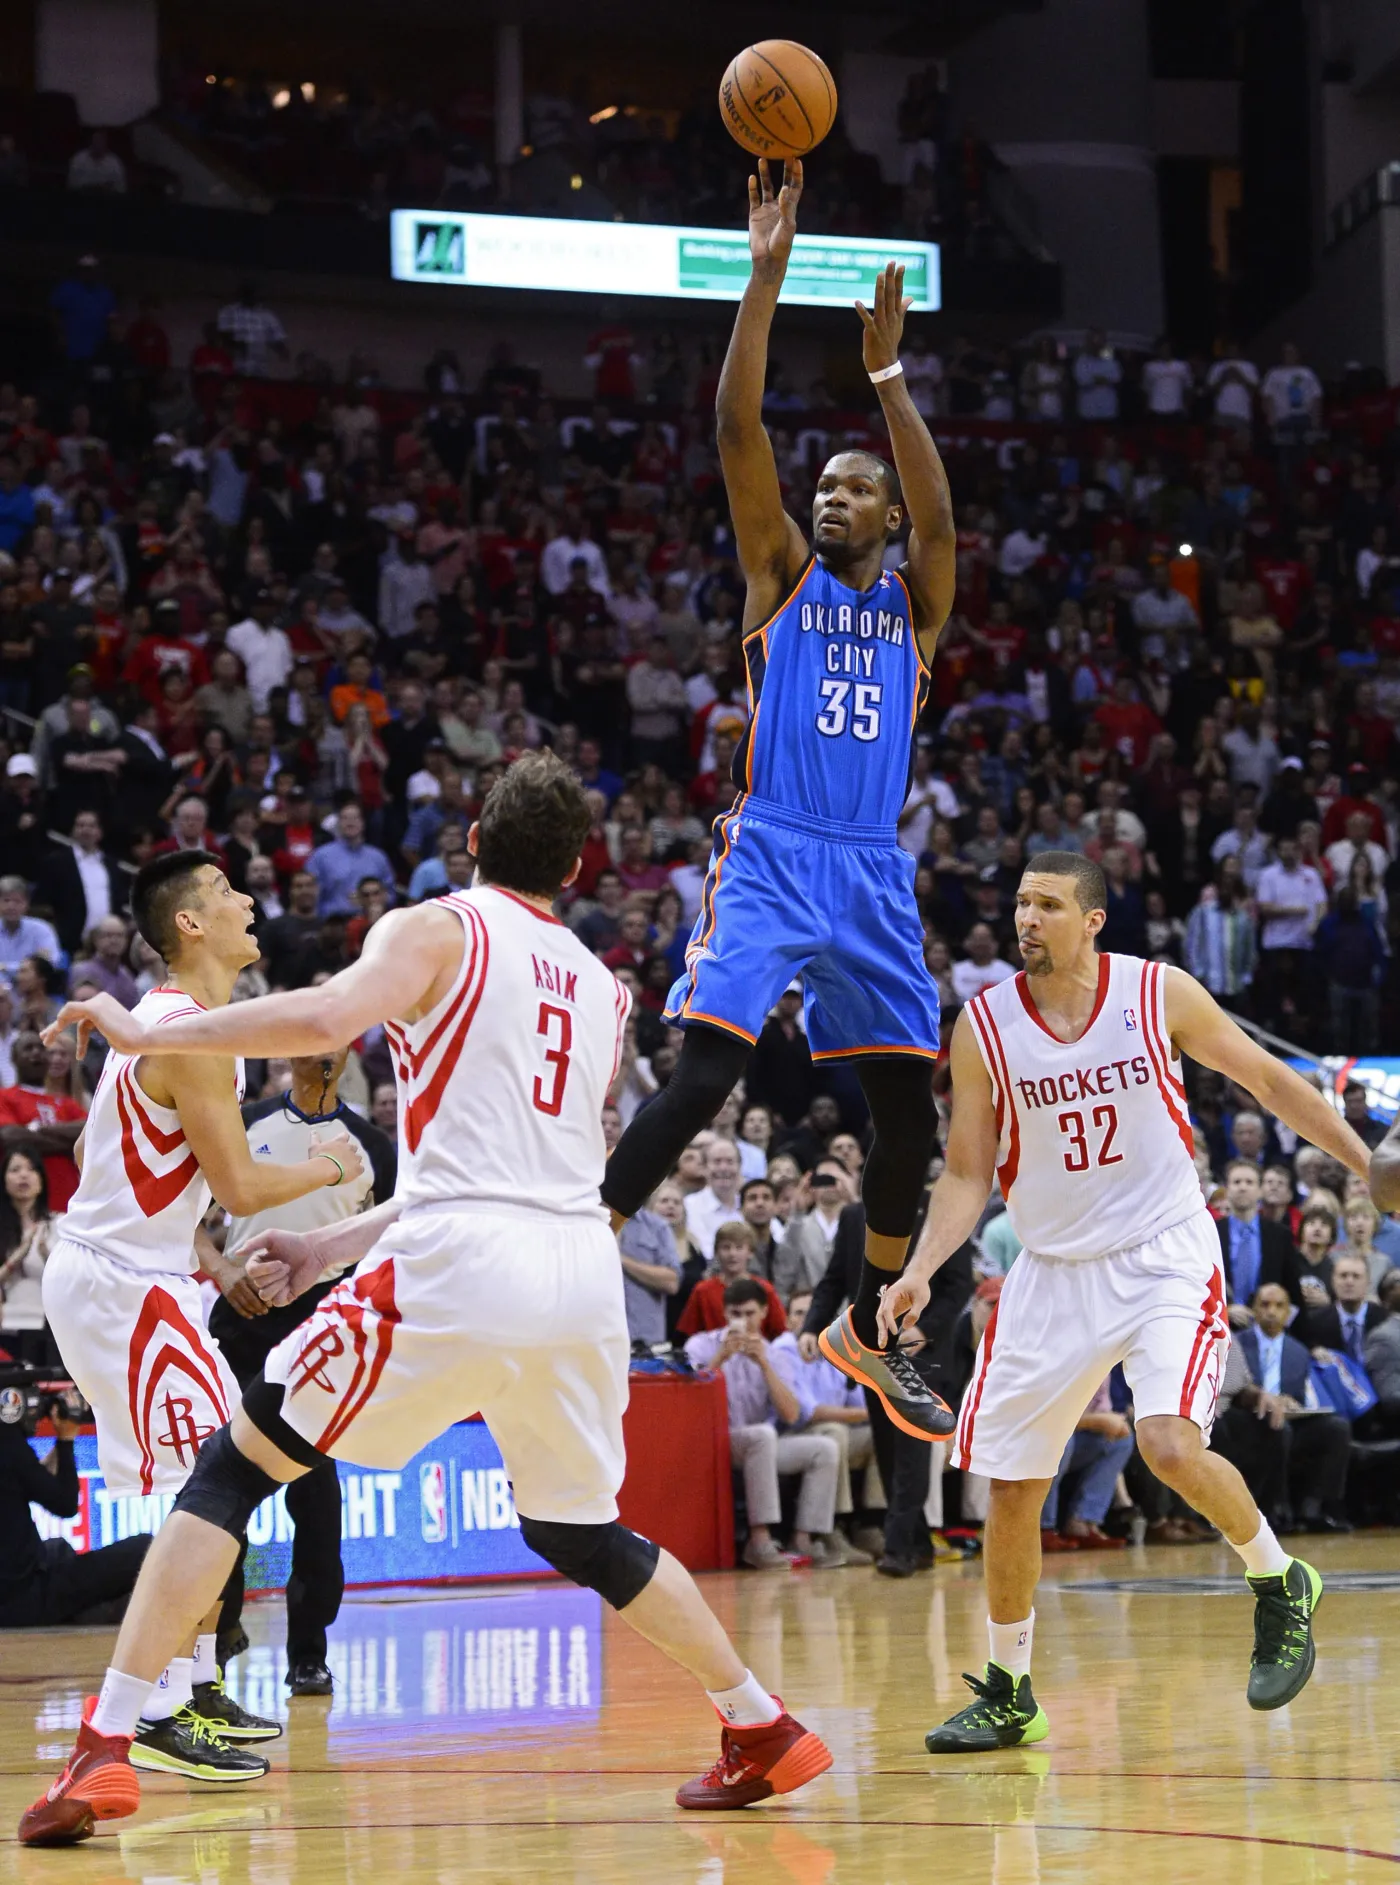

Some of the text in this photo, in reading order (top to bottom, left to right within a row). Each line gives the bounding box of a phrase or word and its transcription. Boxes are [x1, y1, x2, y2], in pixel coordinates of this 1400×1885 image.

[826, 642, 875, 678] CITY
[815, 677, 883, 742] 35
[531, 953, 578, 1003] ASIK
[532, 1001, 572, 1118] 3
[1015, 1055, 1150, 1111] ROCKETS
[1057, 1103, 1124, 1173] 32
